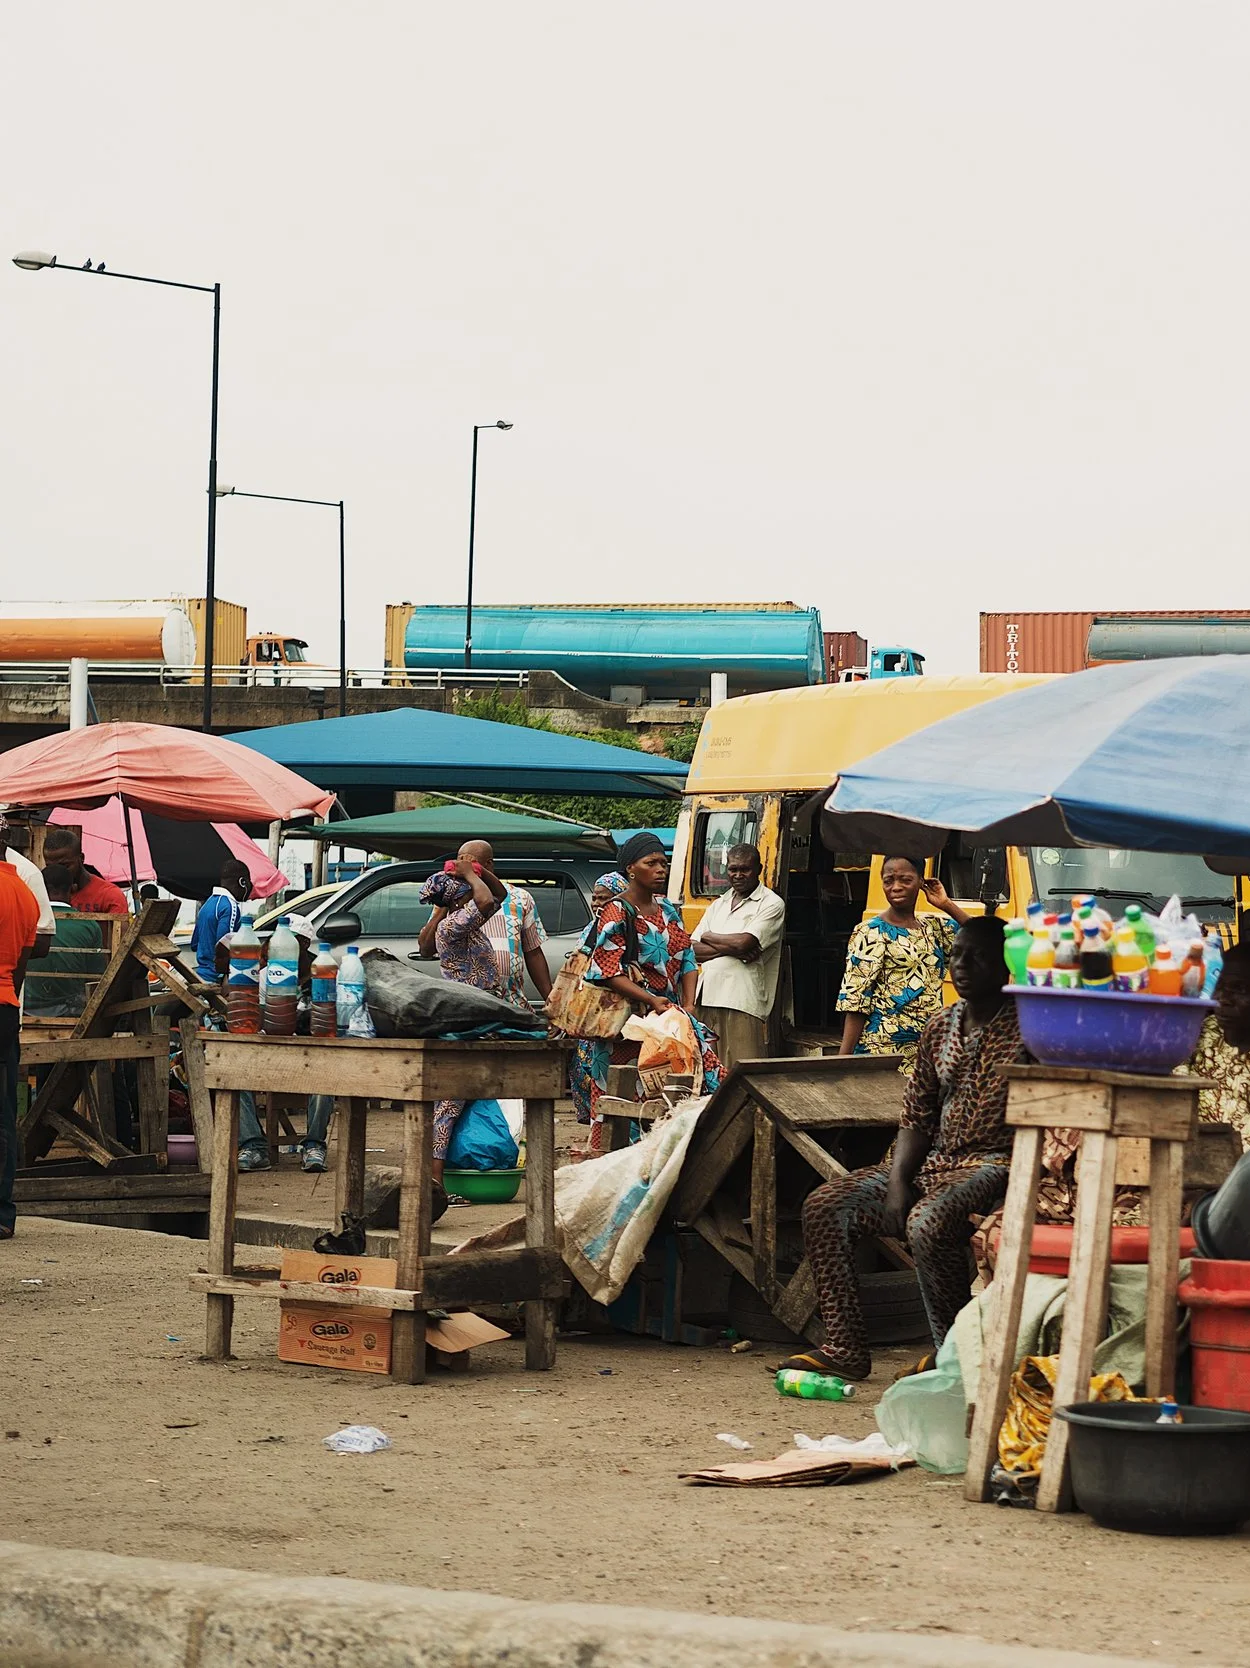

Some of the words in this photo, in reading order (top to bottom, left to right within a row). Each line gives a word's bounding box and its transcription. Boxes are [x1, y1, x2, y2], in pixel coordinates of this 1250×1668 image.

[1006, 624, 1019, 674] TRITO
[321, 1269, 358, 1283] Gala
[312, 1323, 349, 1336] Gala
[340, 1345, 355, 1356] Roll
